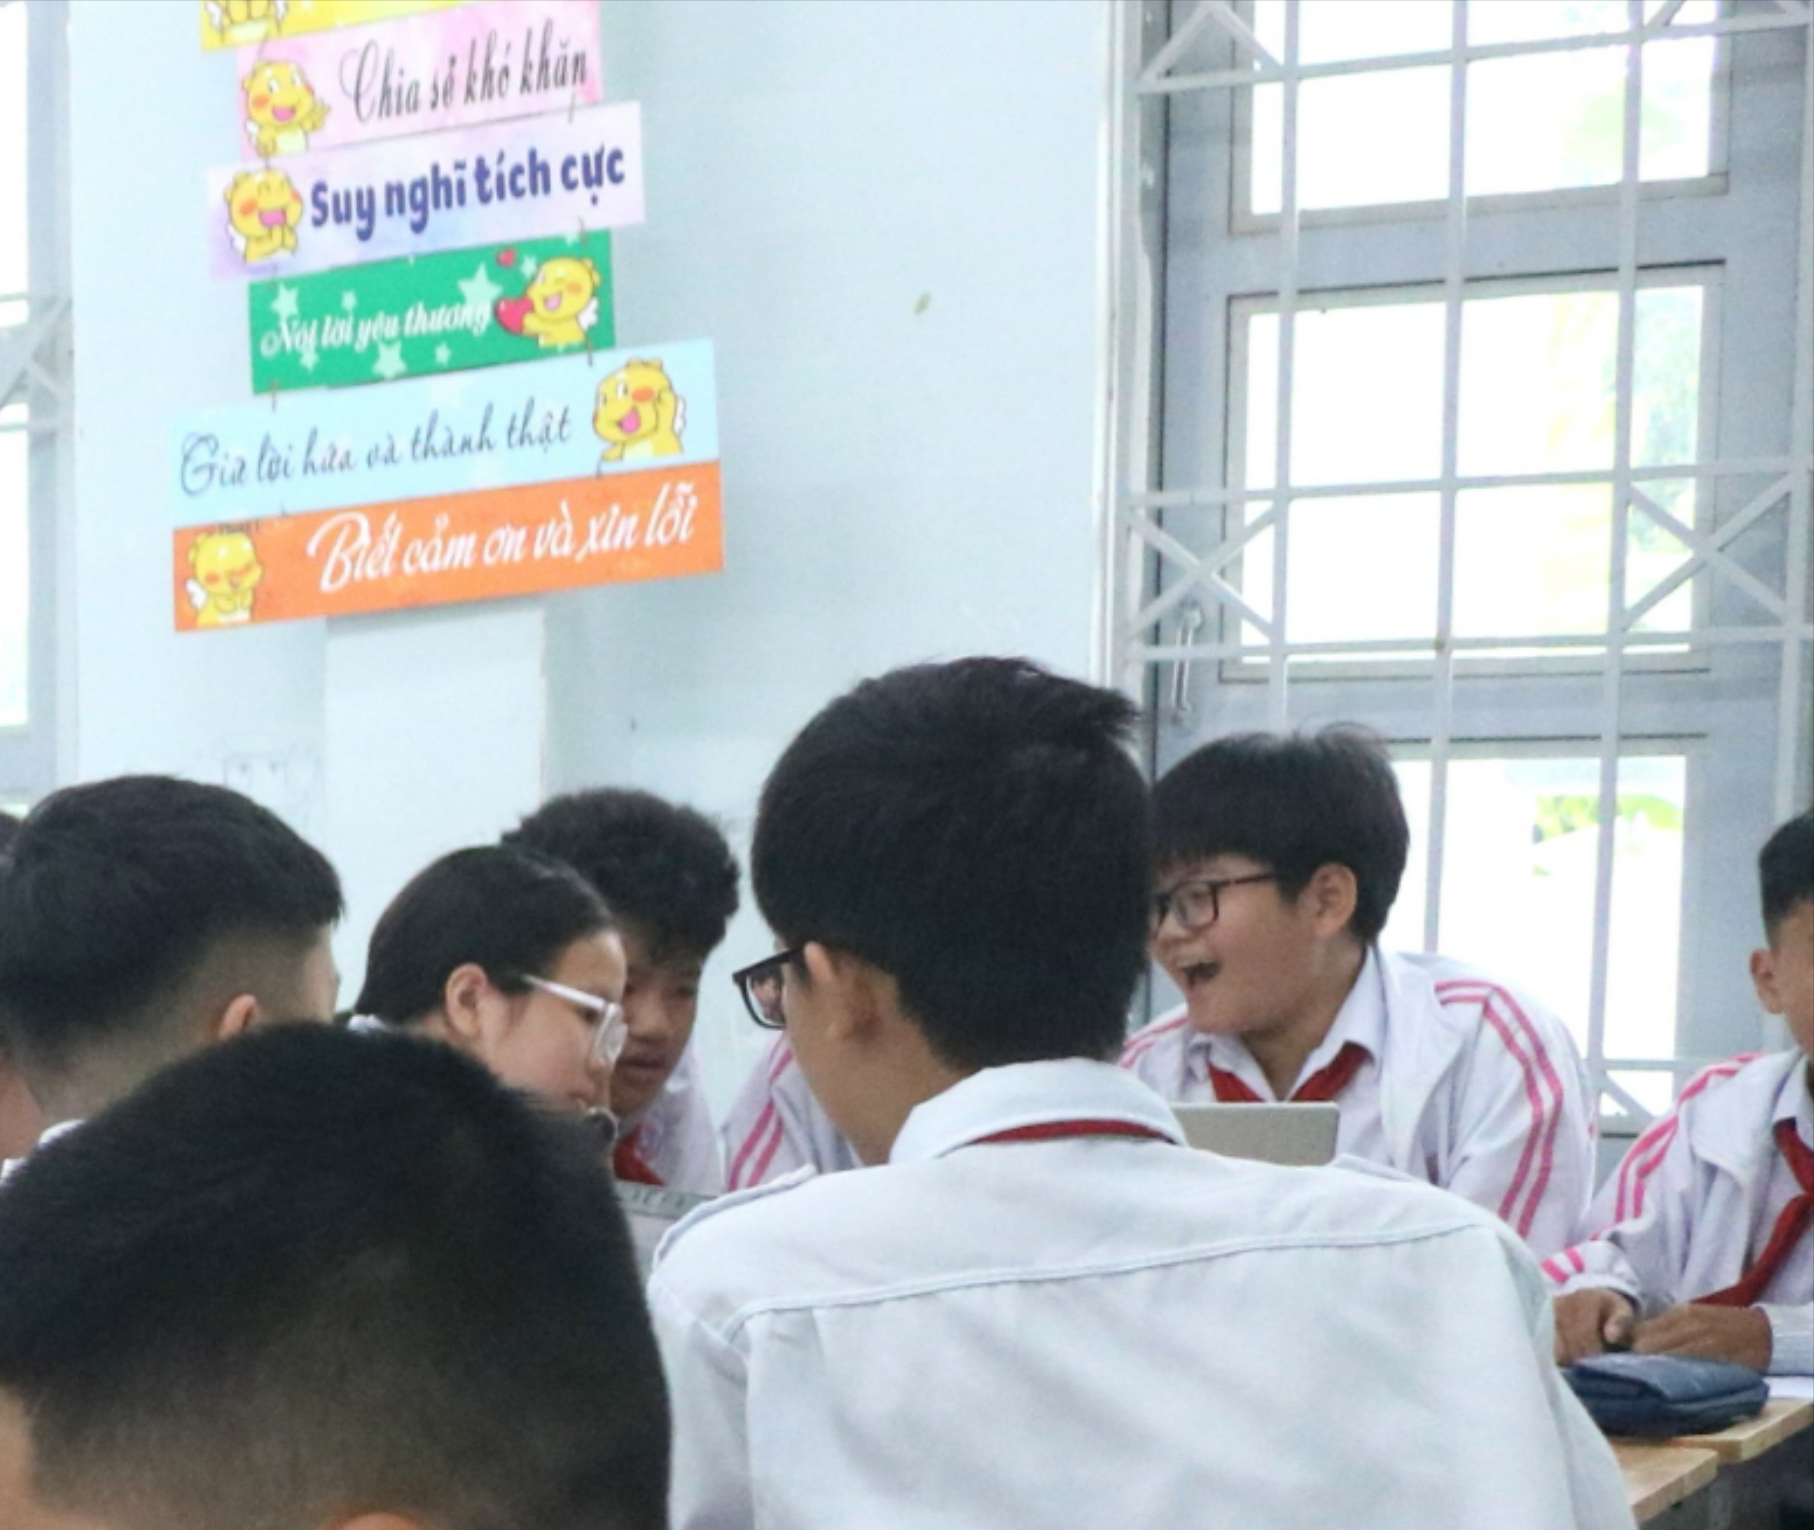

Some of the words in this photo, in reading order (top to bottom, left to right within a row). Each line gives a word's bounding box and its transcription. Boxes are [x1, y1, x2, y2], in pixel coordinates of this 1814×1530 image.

[338, 38, 421, 123] Chia
[430, 53, 457, 111] sẻ
[463, 28, 512, 104] khó
[519, 17, 587, 96] khăn
[310, 179, 376, 242] Suy
[385, 157, 468, 235] nghĩ
[475, 149, 551, 206] tích
[560, 142, 626, 206] cực
[365, 413, 400, 464] và
[410, 402, 497, 461] thành
[506, 396, 572, 454] thật
[307, 511, 403, 593] Biết
[402, 512, 474, 575] cảm
[482, 523, 528, 567] ơn
[533, 499, 574, 560] và
[575, 503, 640, 562] xin
[644, 482, 698, 547] lỗi
